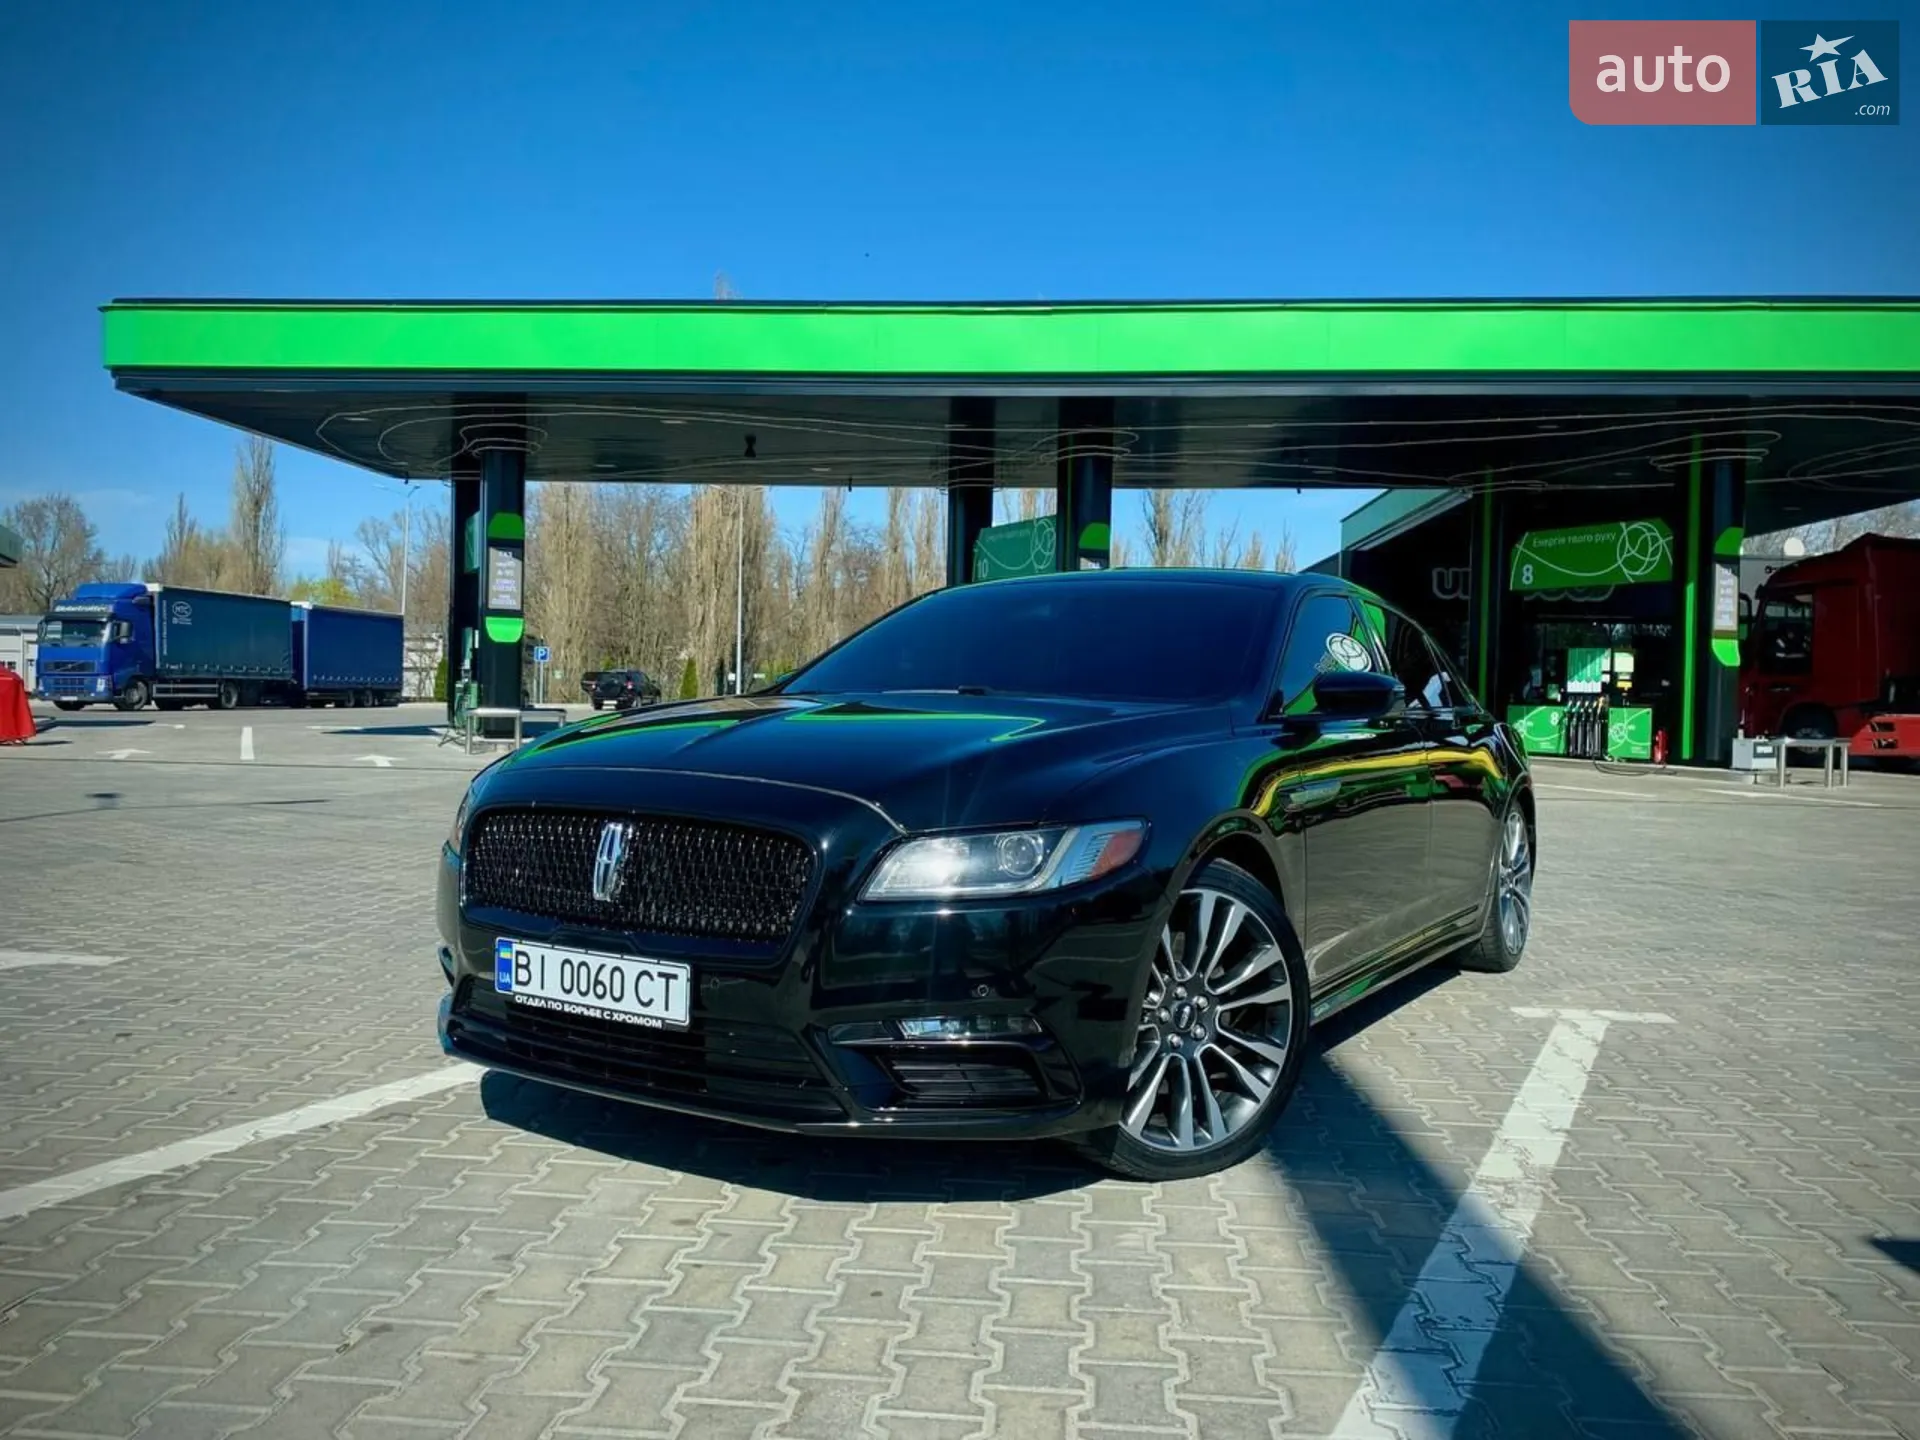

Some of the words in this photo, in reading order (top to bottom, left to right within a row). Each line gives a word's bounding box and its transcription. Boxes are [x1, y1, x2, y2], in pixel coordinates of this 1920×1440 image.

[977, 558, 989, 579] 10
[1522, 563, 1534, 585] 8
[1550, 711, 1559, 725] 8
[499, 971, 512, 984] UA
[515, 950, 545, 989] BI
[560, 957, 625, 1003] 0060
[634, 970, 678, 1012] CT
[515, 995, 547, 1008] ОТДЕЛ
[547, 1000, 562, 1011] ПО
[563, 1003, 602, 1019] БОРЬБЕ
[603, 1010, 611, 1020] С
[611, 1012, 662, 1028] ХРОМОМ
